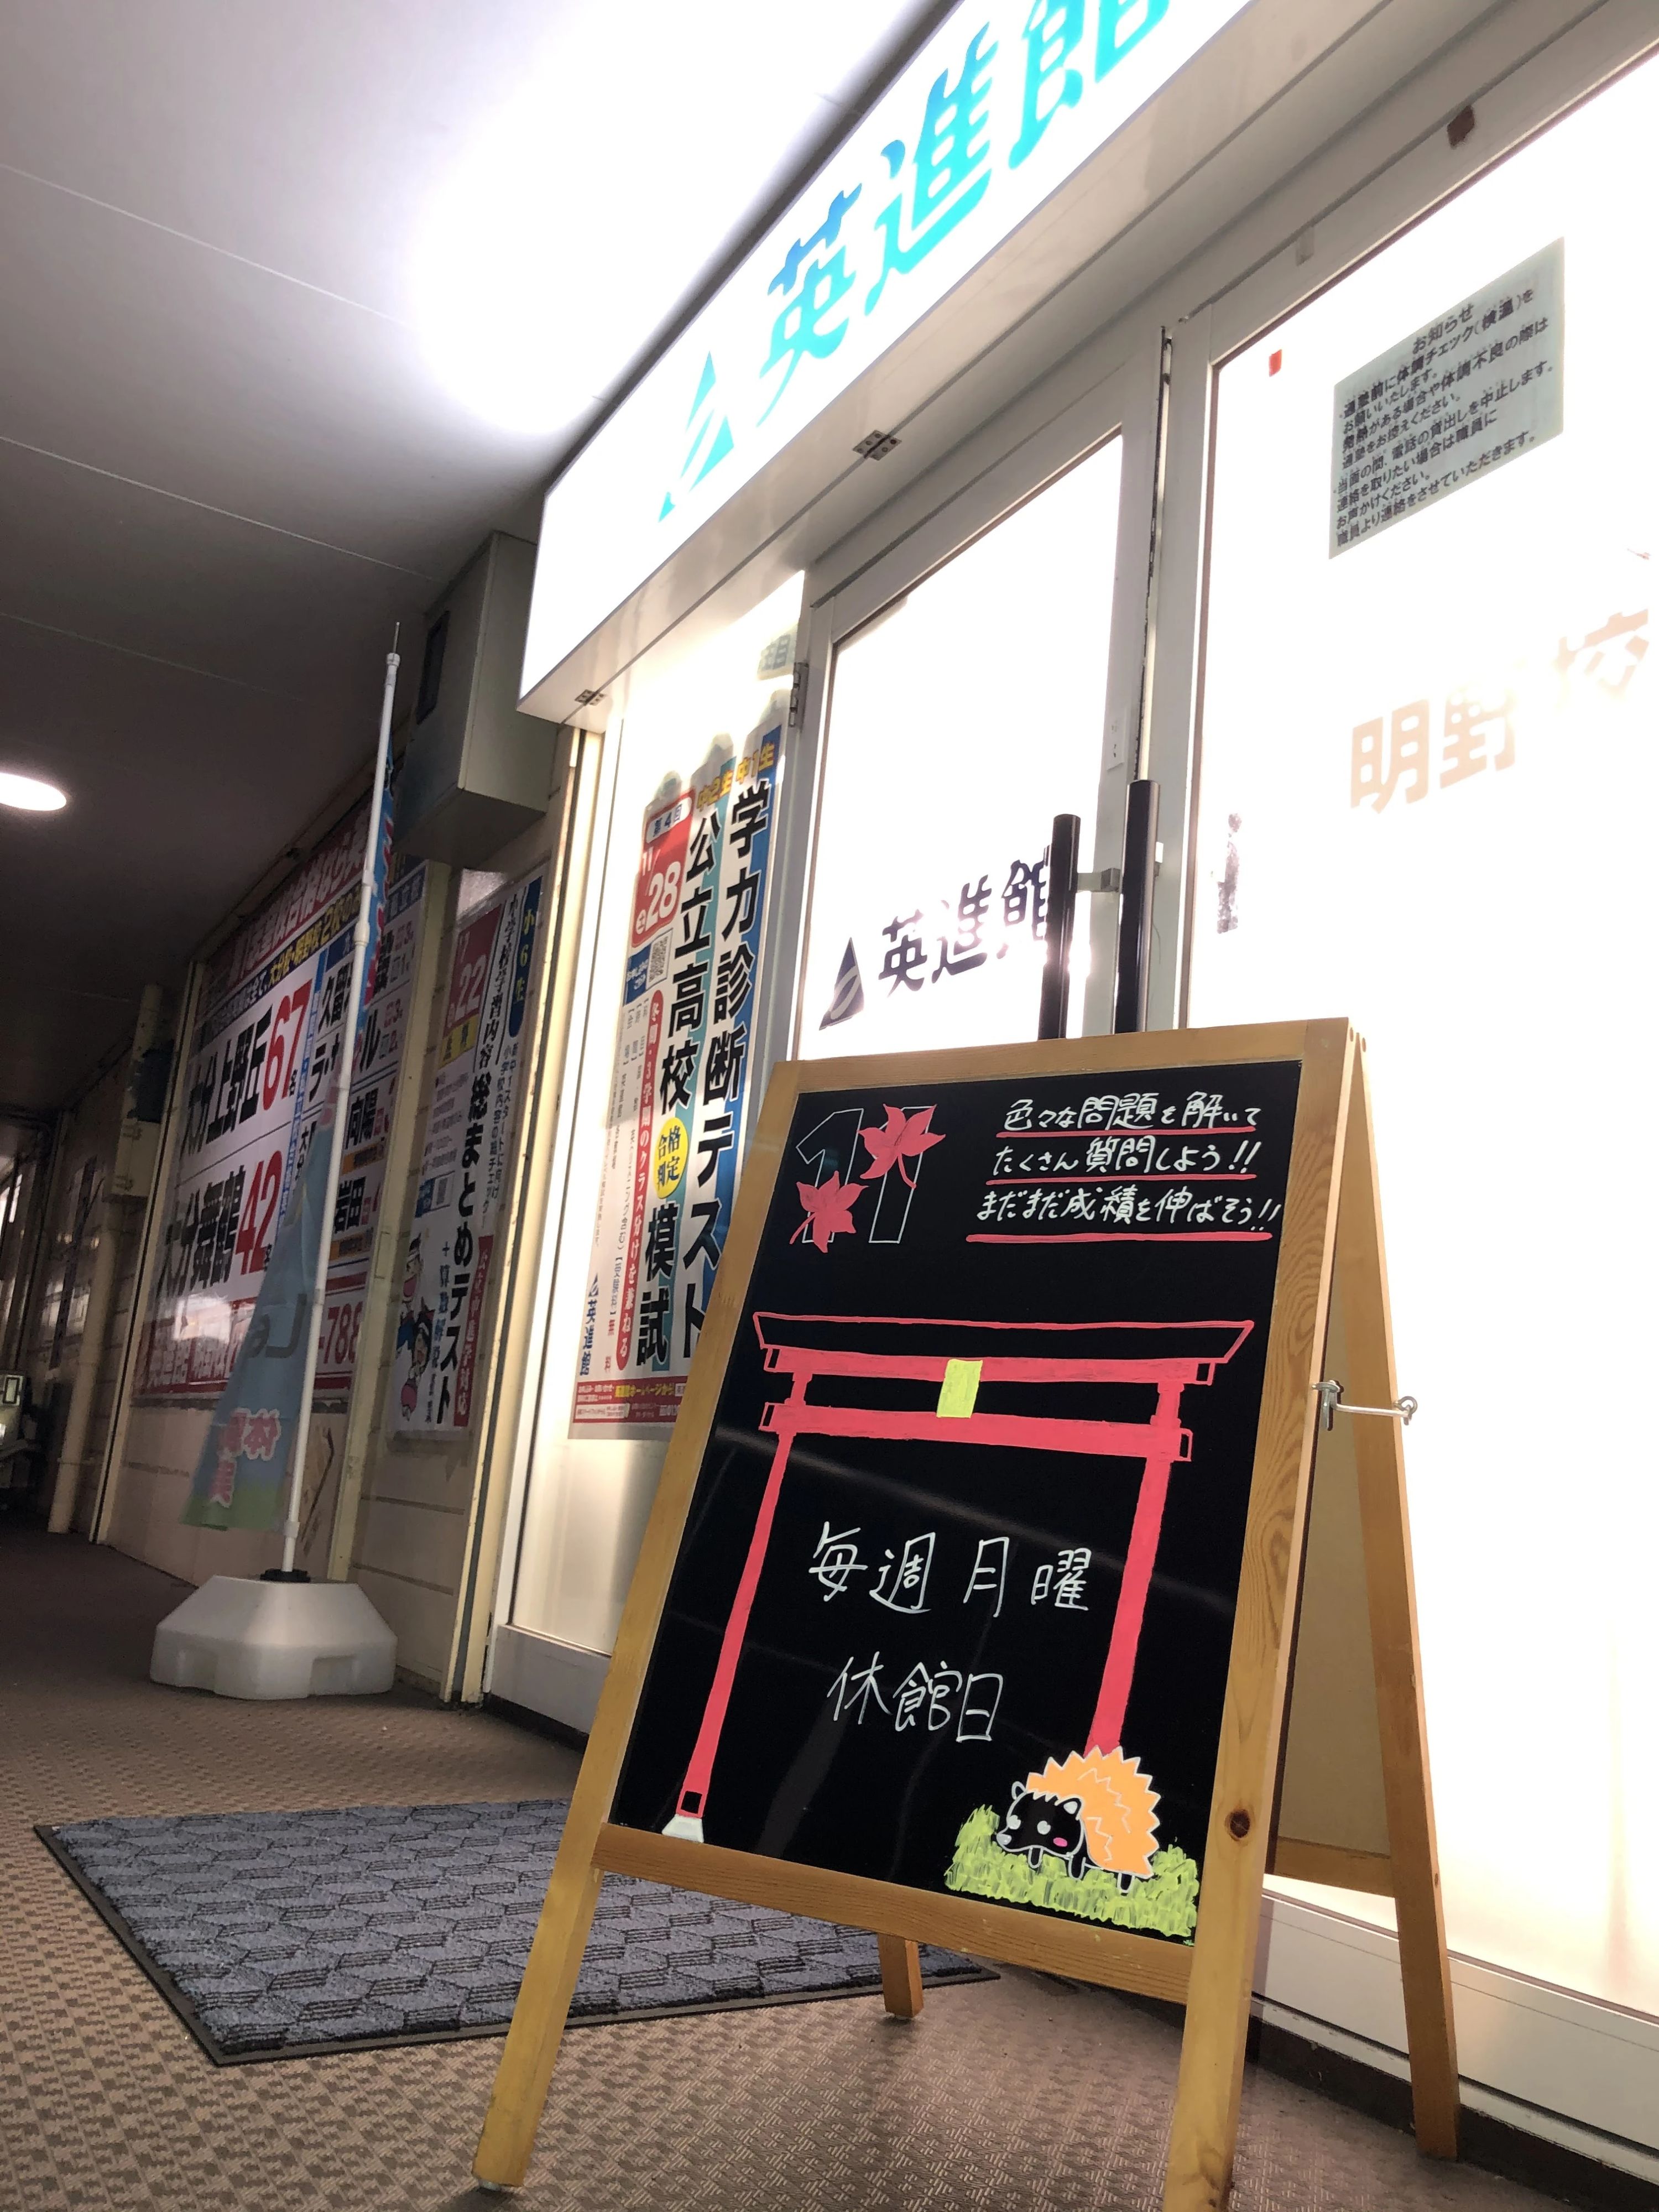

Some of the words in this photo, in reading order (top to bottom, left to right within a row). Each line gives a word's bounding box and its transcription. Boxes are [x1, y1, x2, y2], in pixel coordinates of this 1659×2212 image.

[1412, 302, 1475, 355] お知らせ
[1342, 315, 1549, 452] 発熱がある場合や体調不良の際は
[1336, 408, 1498, 513] 連絡を取りたい場合は職員に
[1336, 471, 1431, 530] お声かけください。
[646, 860, 681, 928] 28
[453, 953, 488, 1020] 22
[660, 811, 721, 1115] 公立高校
[262, 979, 313, 1112] 67
[682, 777, 770, 1359] 学力診断テスト
[658, 1124, 681, 1155] 合格
[992, 1135, 1261, 1176] たくさん質問しよう!!
[1003, 1090, 1262, 1131] 色々な問題を解いて
[235, 1150, 283, 1276] 42
[334, 1176, 366, 1234] 岩田
[795, 1105, 936, 1244] 11
[437, 1072, 492, 1424] 総まとめテスト
[636, 1202, 679, 1366] 模試
[808, 1521, 1092, 1618] 毎週月曜
[826, 1651, 1004, 1743] 休館日
